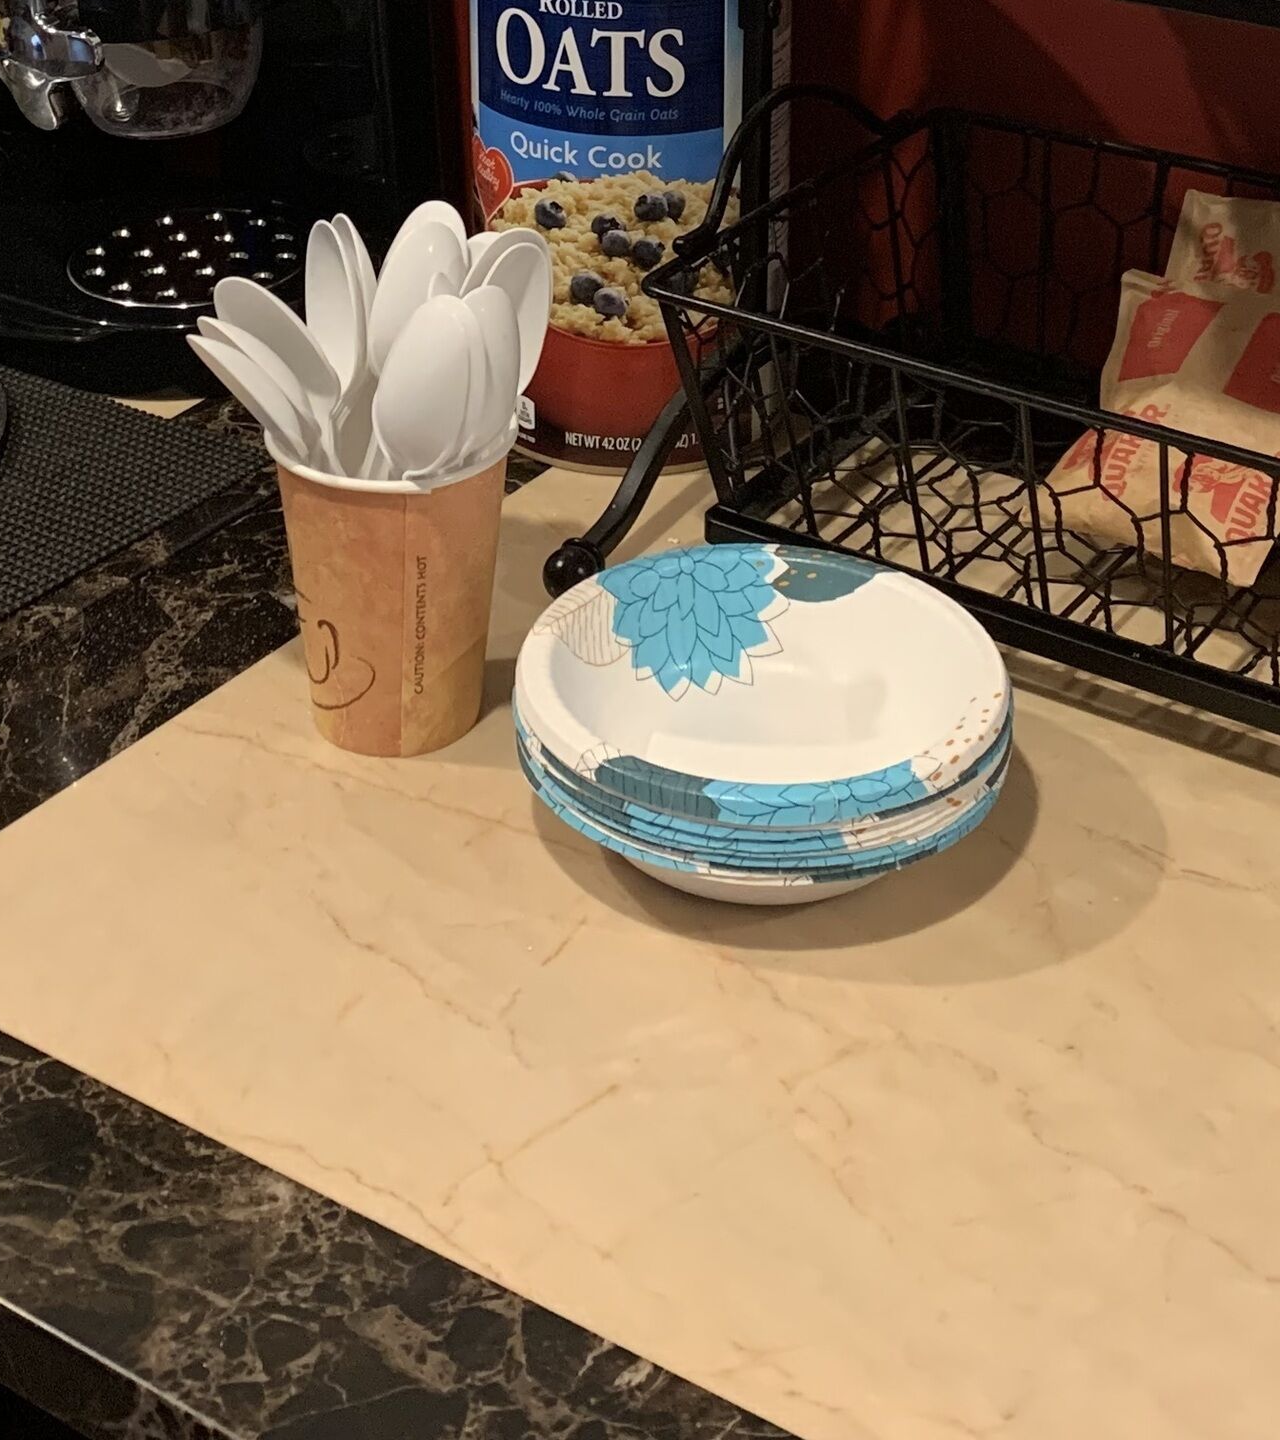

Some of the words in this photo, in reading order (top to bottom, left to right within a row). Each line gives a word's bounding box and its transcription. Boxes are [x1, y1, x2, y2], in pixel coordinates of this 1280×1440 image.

[496, 7, 686, 98] OATS
[500, 88, 531, 110] Hearty
[534, 100, 562, 116] 100%
[566, 105, 605, 120] Whole
[609, 109, 646, 123] Grain
[650, 109, 679, 121] Oats
[510, 131, 579, 166] Quick
[588, 145, 663, 169] Cook
[565, 431, 584, 447] NET
[584, 434, 600, 449] WT
[601, 435, 615, 450] 42
[616, 437, 630, 451] OZ
[416, 555, 427, 580] HOT
[415, 582, 426, 640] CONTENTS
